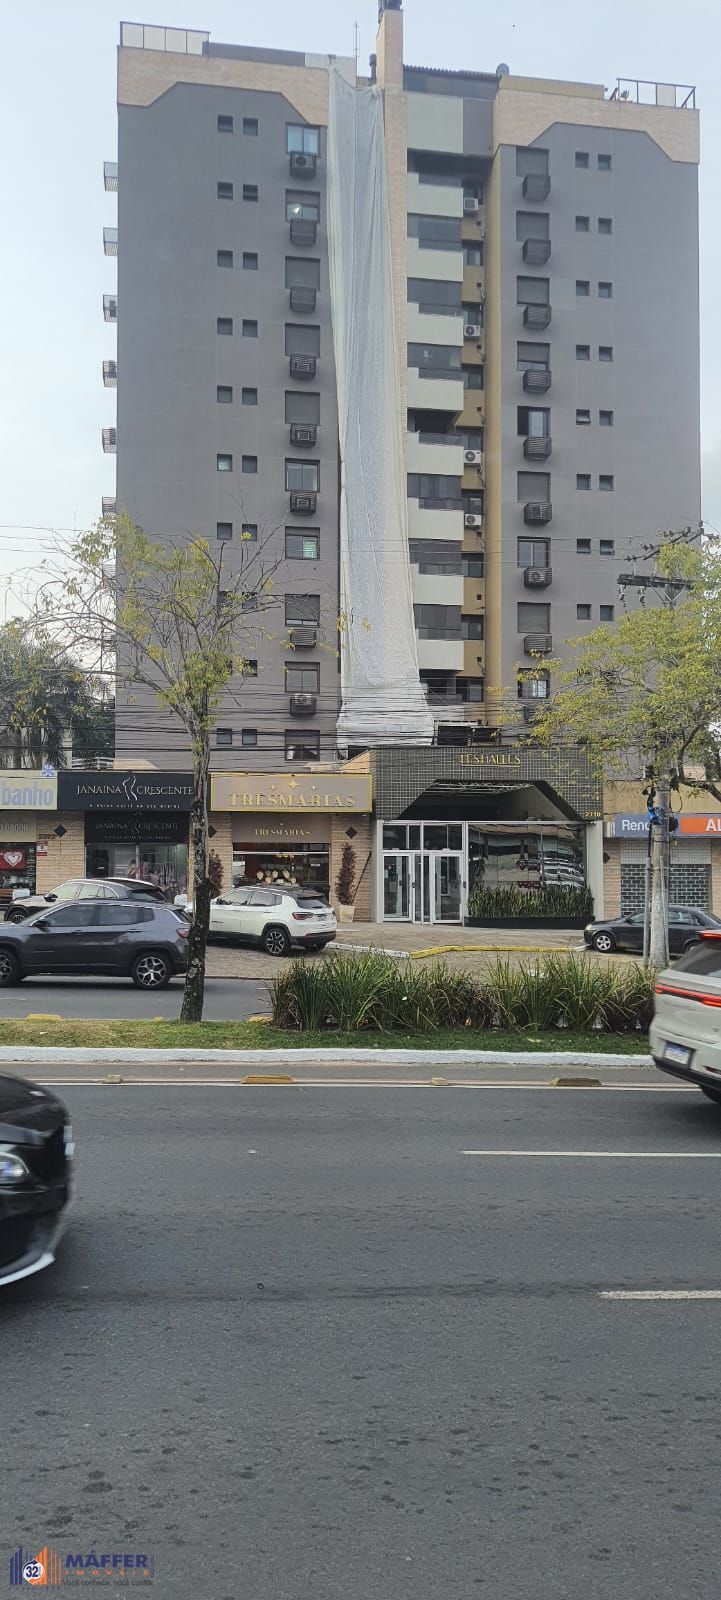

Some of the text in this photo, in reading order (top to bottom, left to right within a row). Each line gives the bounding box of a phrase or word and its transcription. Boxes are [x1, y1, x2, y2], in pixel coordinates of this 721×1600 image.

[1, 781, 54, 806] banho
[76, 785, 194, 796] JANAINA CRESCENTE
